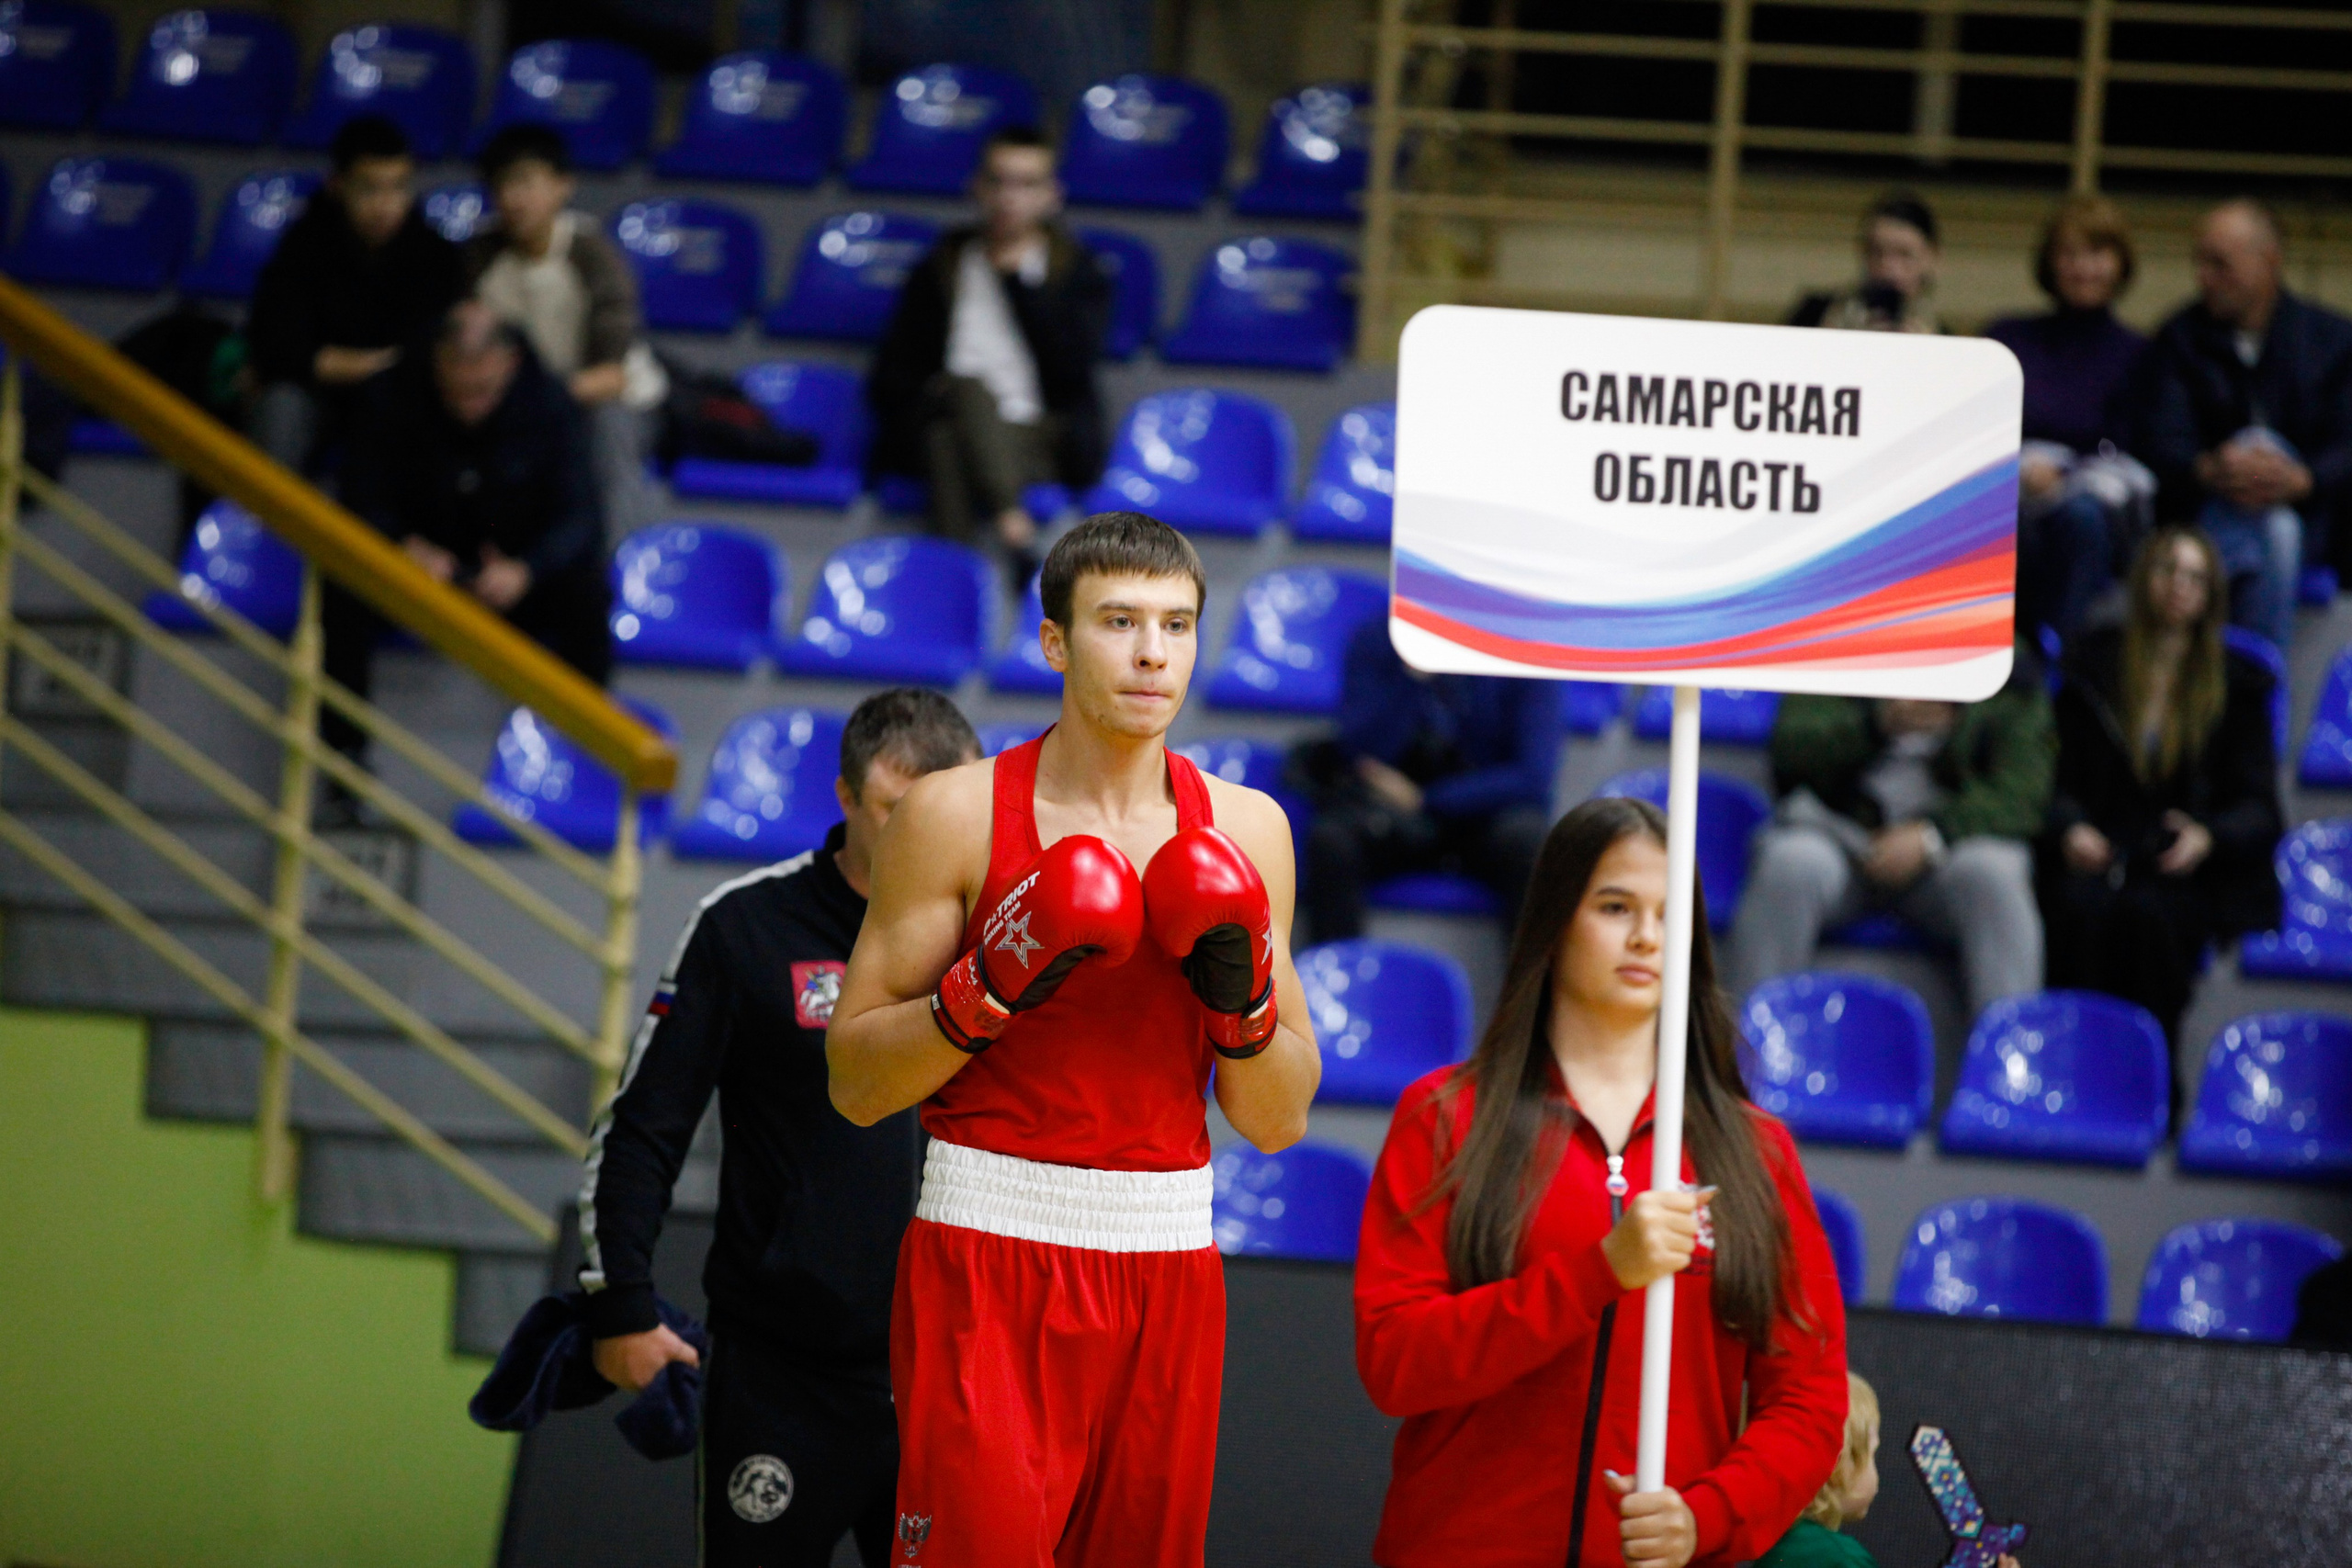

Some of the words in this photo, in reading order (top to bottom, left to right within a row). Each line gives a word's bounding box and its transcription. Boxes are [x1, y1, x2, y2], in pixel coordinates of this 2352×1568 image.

[1560, 370, 1861, 438] САМАРСКАЯ
[1593, 452, 1822, 514] ОБЛАСТЬ
[984, 919, 1004, 946] BOXING
[1003, 900, 1022, 921] TEAM
